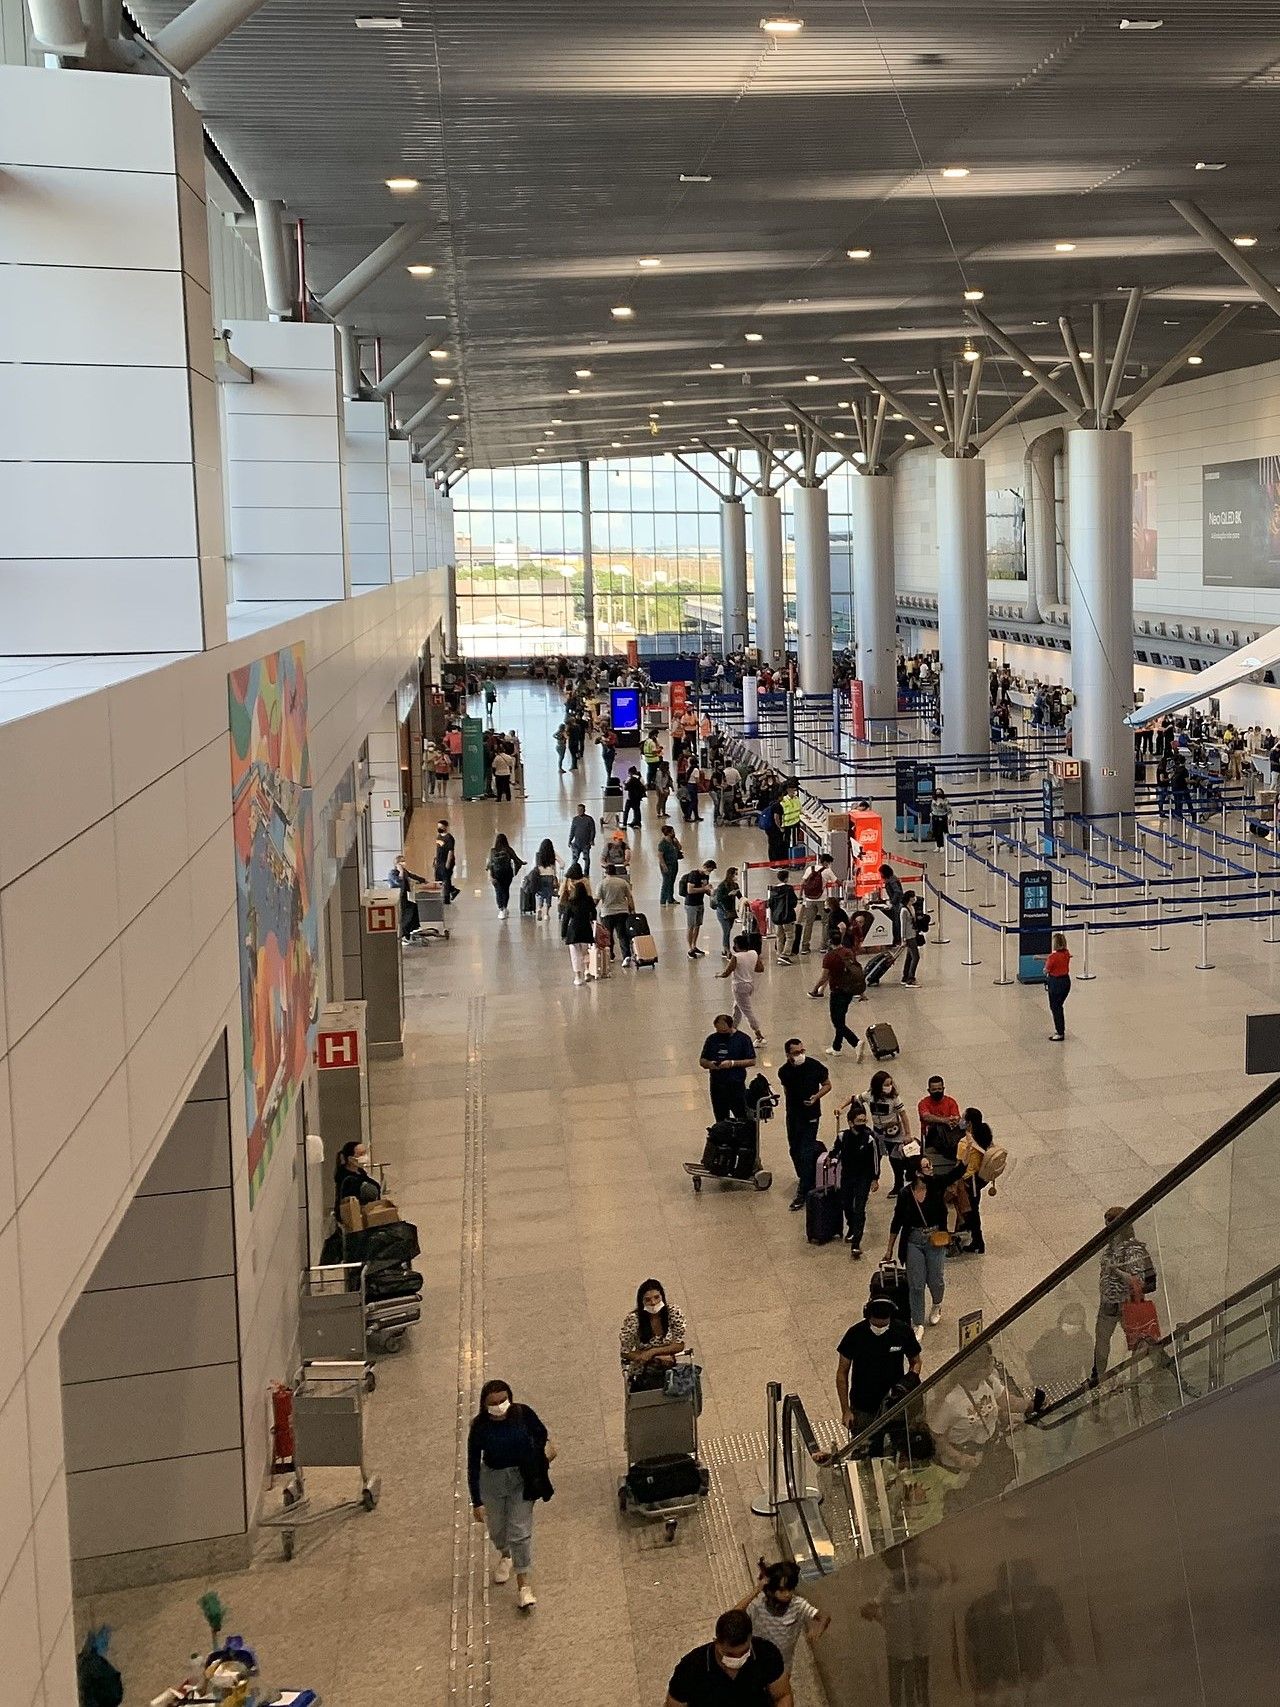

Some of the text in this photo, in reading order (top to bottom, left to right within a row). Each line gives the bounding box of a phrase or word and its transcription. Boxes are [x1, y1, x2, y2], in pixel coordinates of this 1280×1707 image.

[1208, 512, 1221, 525] Neo
[1066, 763, 1078, 776] H
[371, 909, 393, 929] H
[325, 1036, 351, 1064] H
